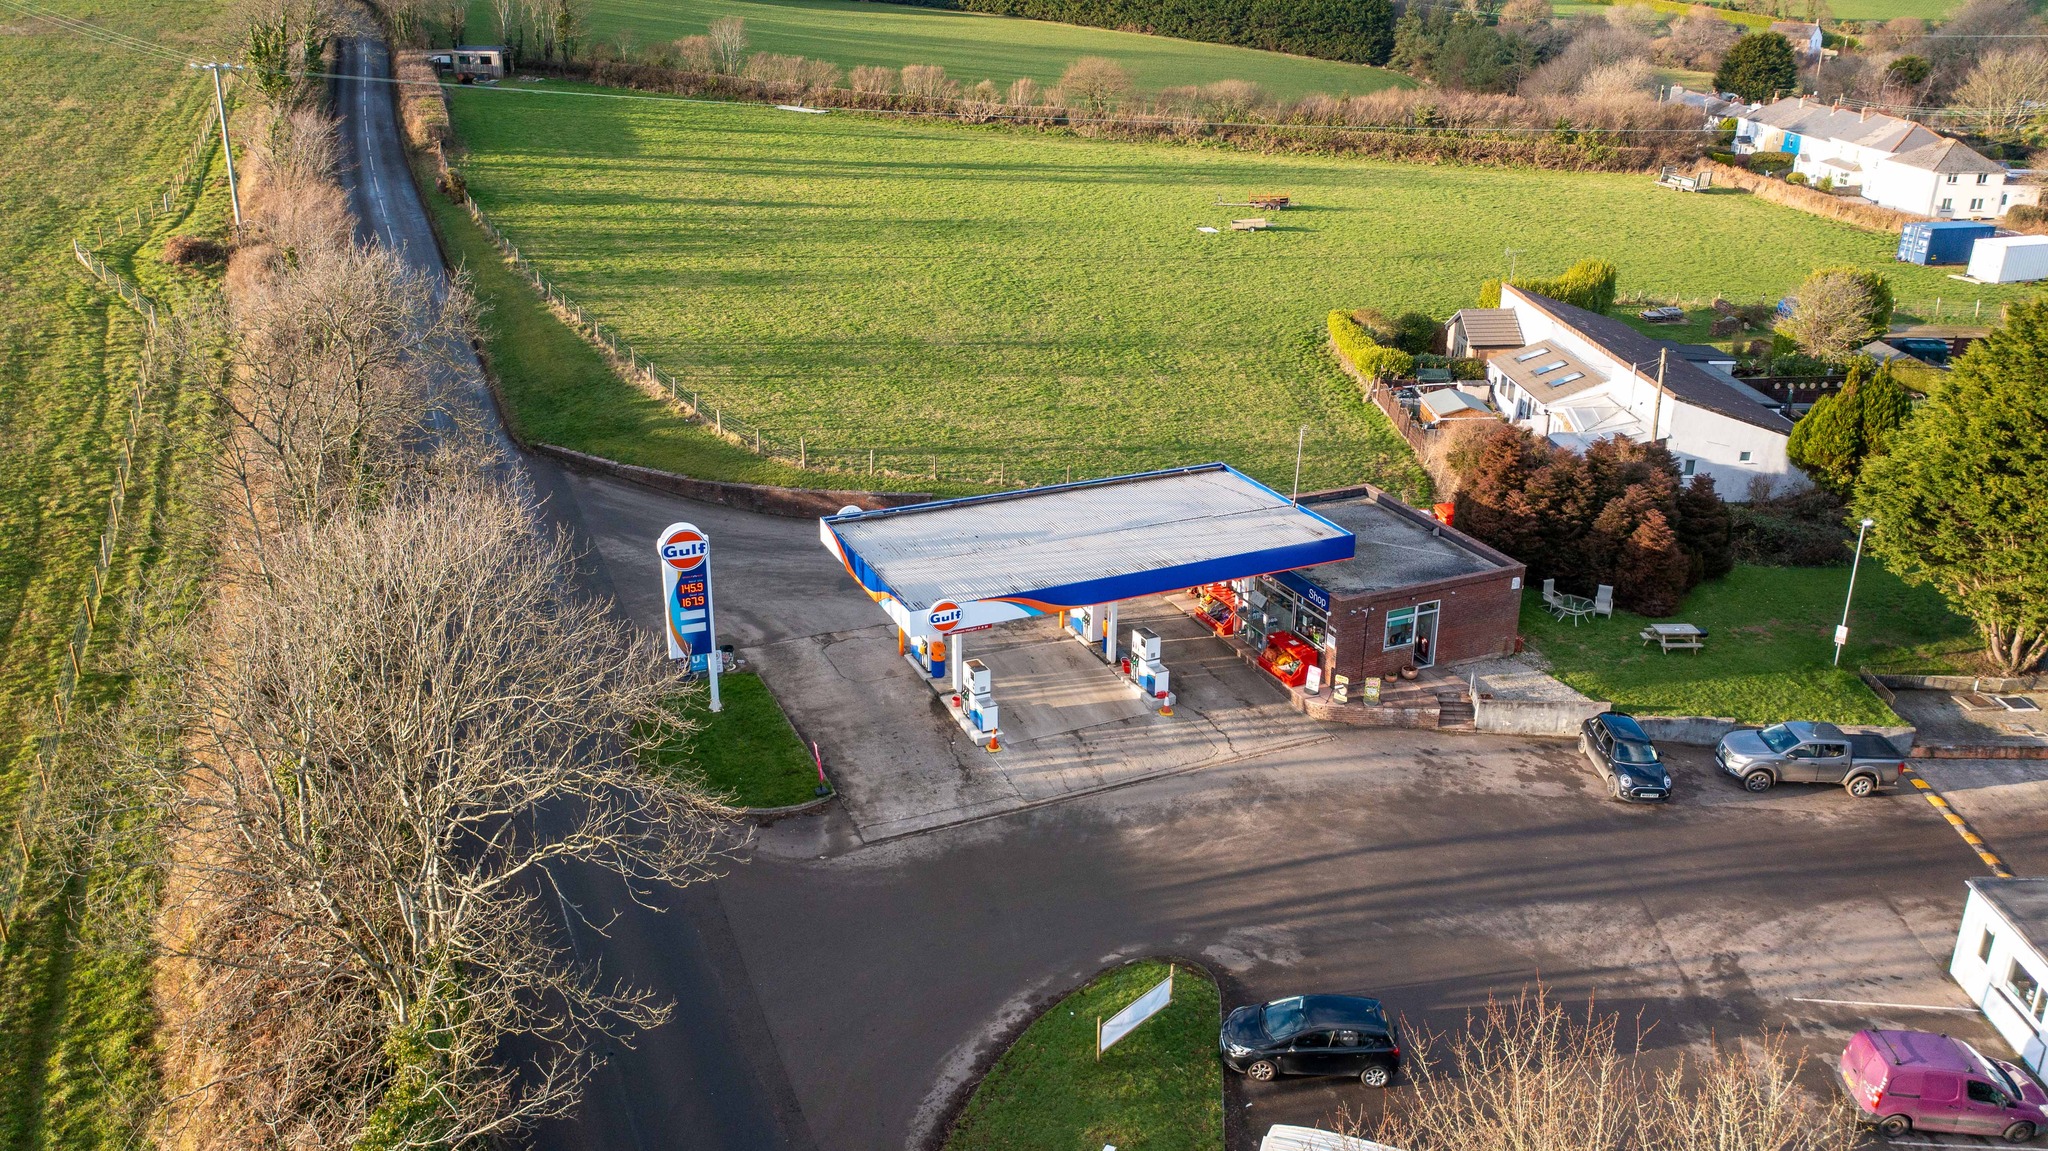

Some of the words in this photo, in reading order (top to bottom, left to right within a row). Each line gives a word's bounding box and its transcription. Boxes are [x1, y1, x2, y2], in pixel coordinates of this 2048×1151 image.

[664, 543, 706, 557] Gulf
[681, 583, 704, 594] 145.9
[682, 596, 705, 607] 167.9
[1308, 589, 1326, 607] Shop
[930, 611, 961, 623] Gulf
